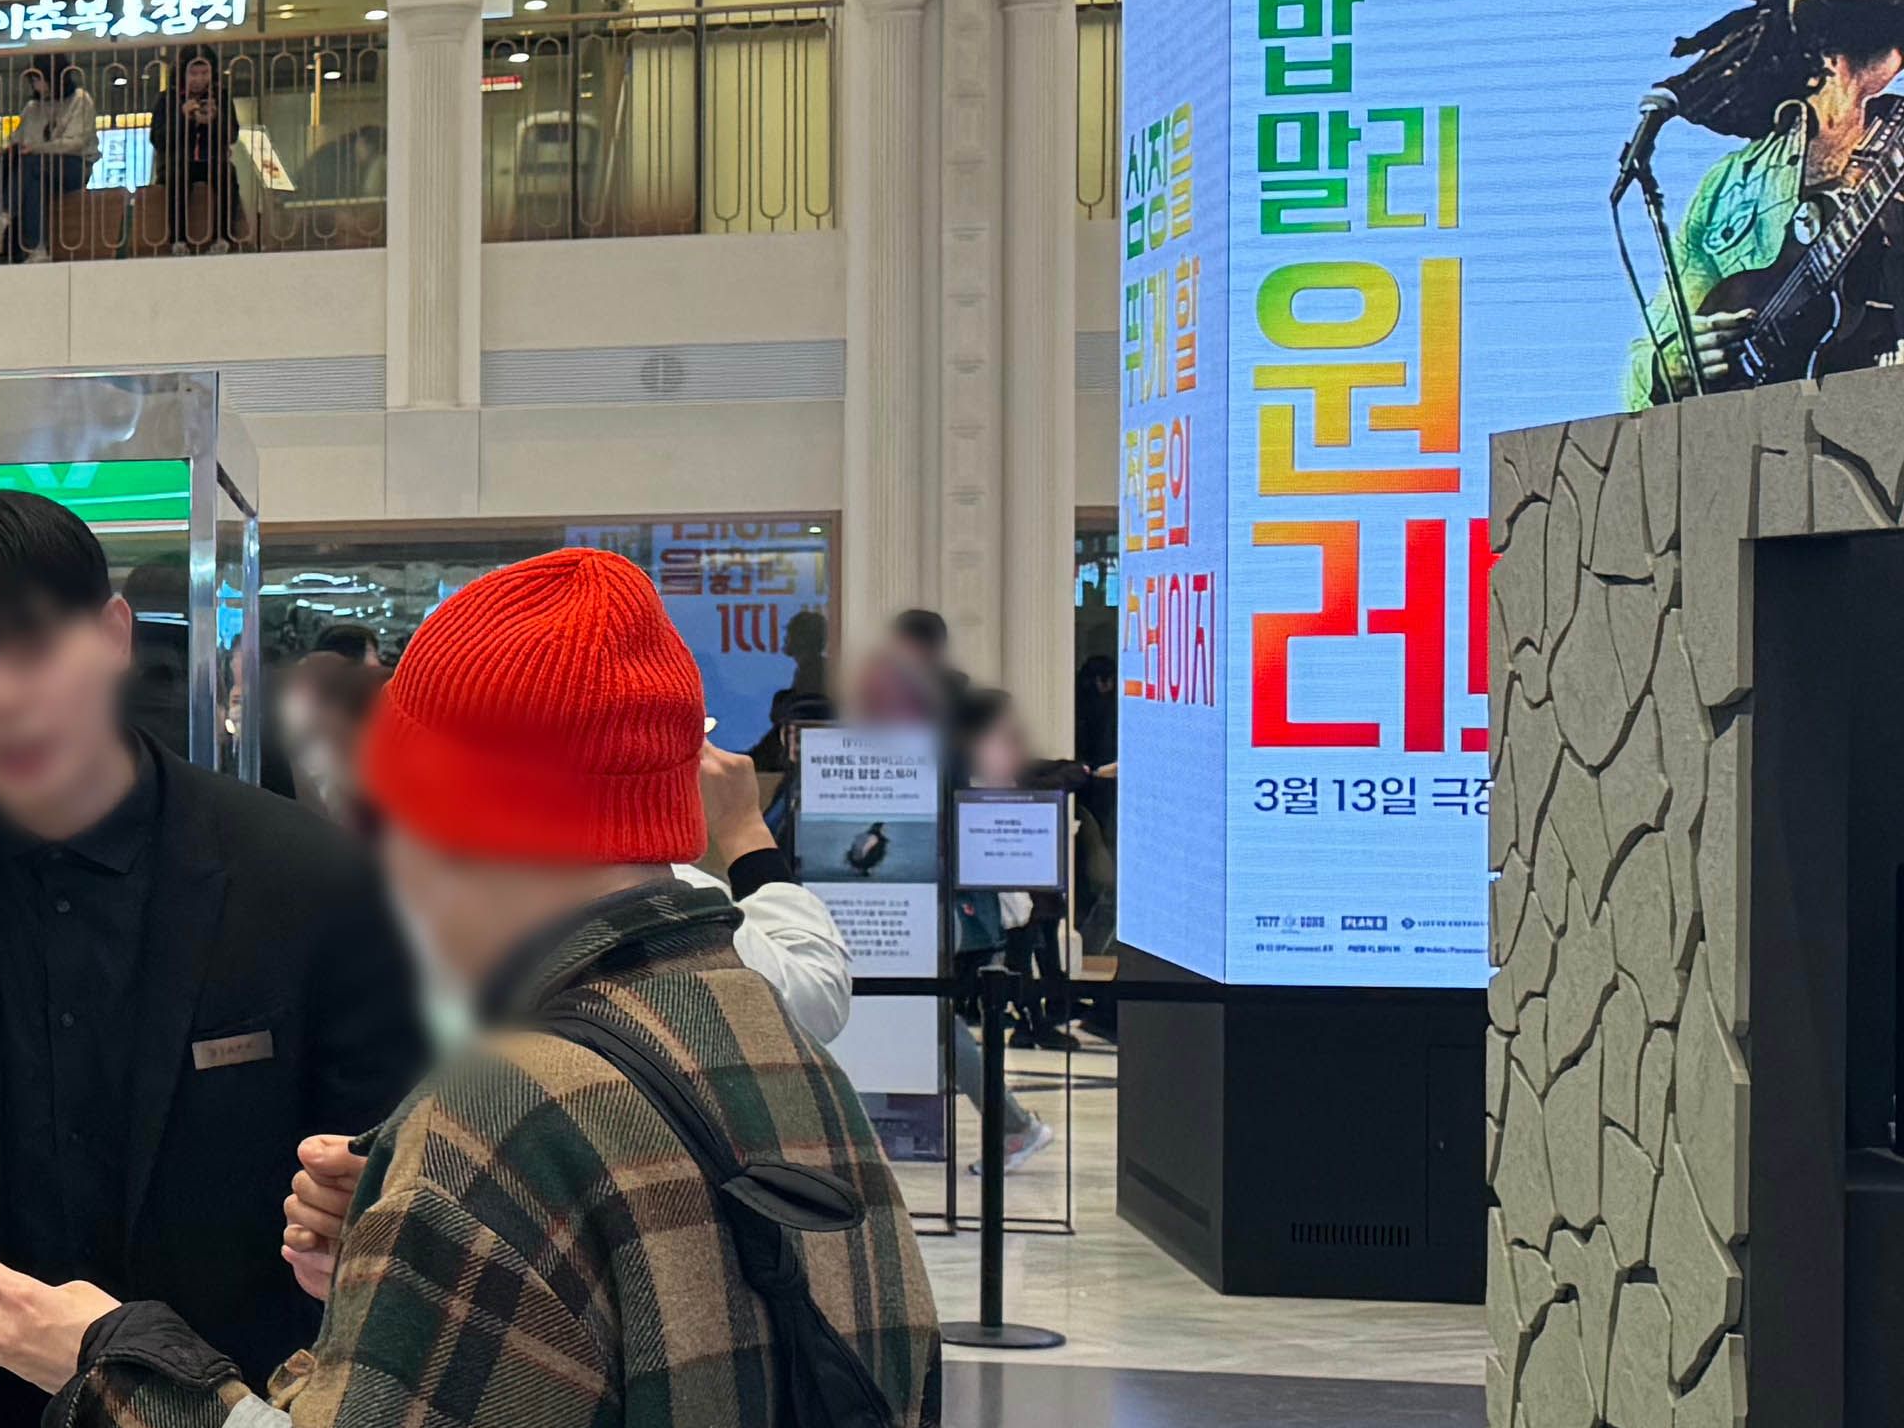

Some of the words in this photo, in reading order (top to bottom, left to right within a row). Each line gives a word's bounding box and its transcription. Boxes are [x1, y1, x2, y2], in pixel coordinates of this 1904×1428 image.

[1126, 102, 1194, 260] 심장을
[1258, 105, 1459, 234] 말리
[1175, 253, 1201, 394] 할
[1253, 257, 1461, 496] 원
[1123, 572, 1215, 707] 스테이지
[1254, 777, 1319, 815] 3월
[1332, 777, 1417, 815] 13일
